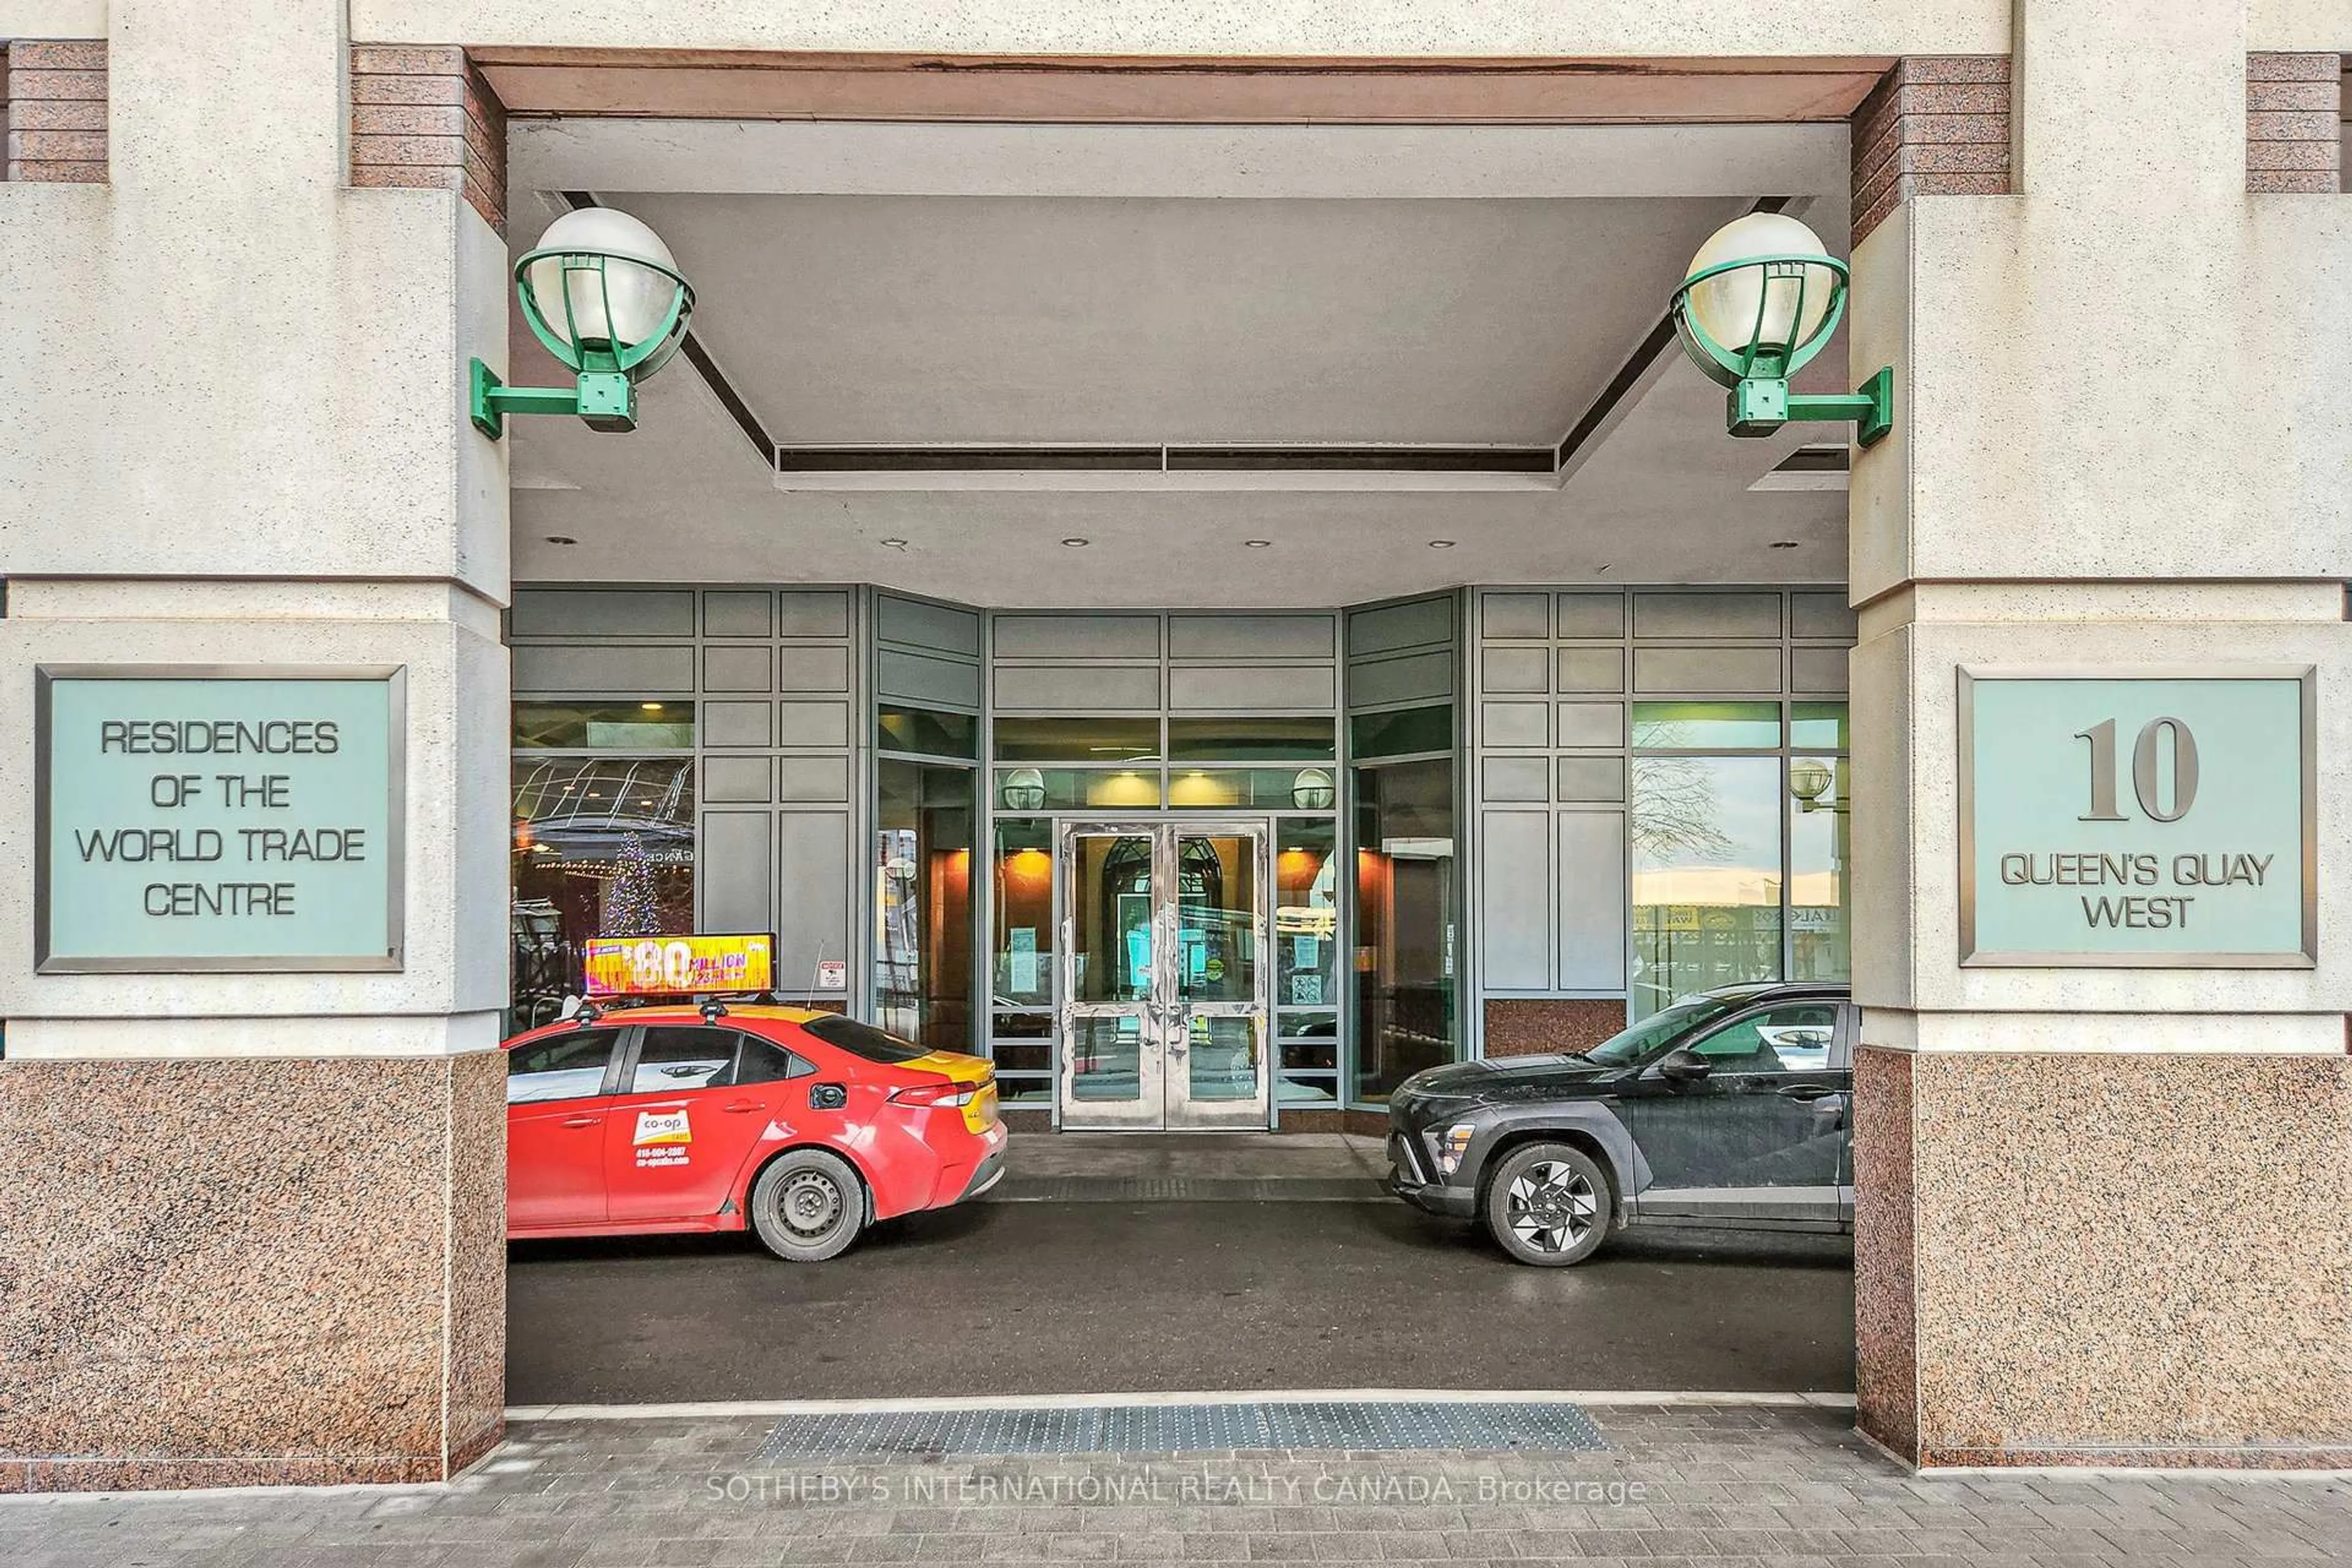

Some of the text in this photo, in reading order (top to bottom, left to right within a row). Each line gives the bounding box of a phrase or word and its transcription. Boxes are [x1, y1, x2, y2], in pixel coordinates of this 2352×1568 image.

[101, 721, 339, 754] RESIDENCES
[2074, 716, 2199, 823] 10
[151, 775, 290, 808] OF THE
[75, 829, 366, 862] WORLD TRADE
[2001, 853, 2275, 886] QUEEN'S QUAY
[144, 883, 296, 916] CENTRE
[2081, 895, 2195, 929] WEST
[688, 953, 747, 972] MILLION
[644, 1118, 681, 1131] co-op
